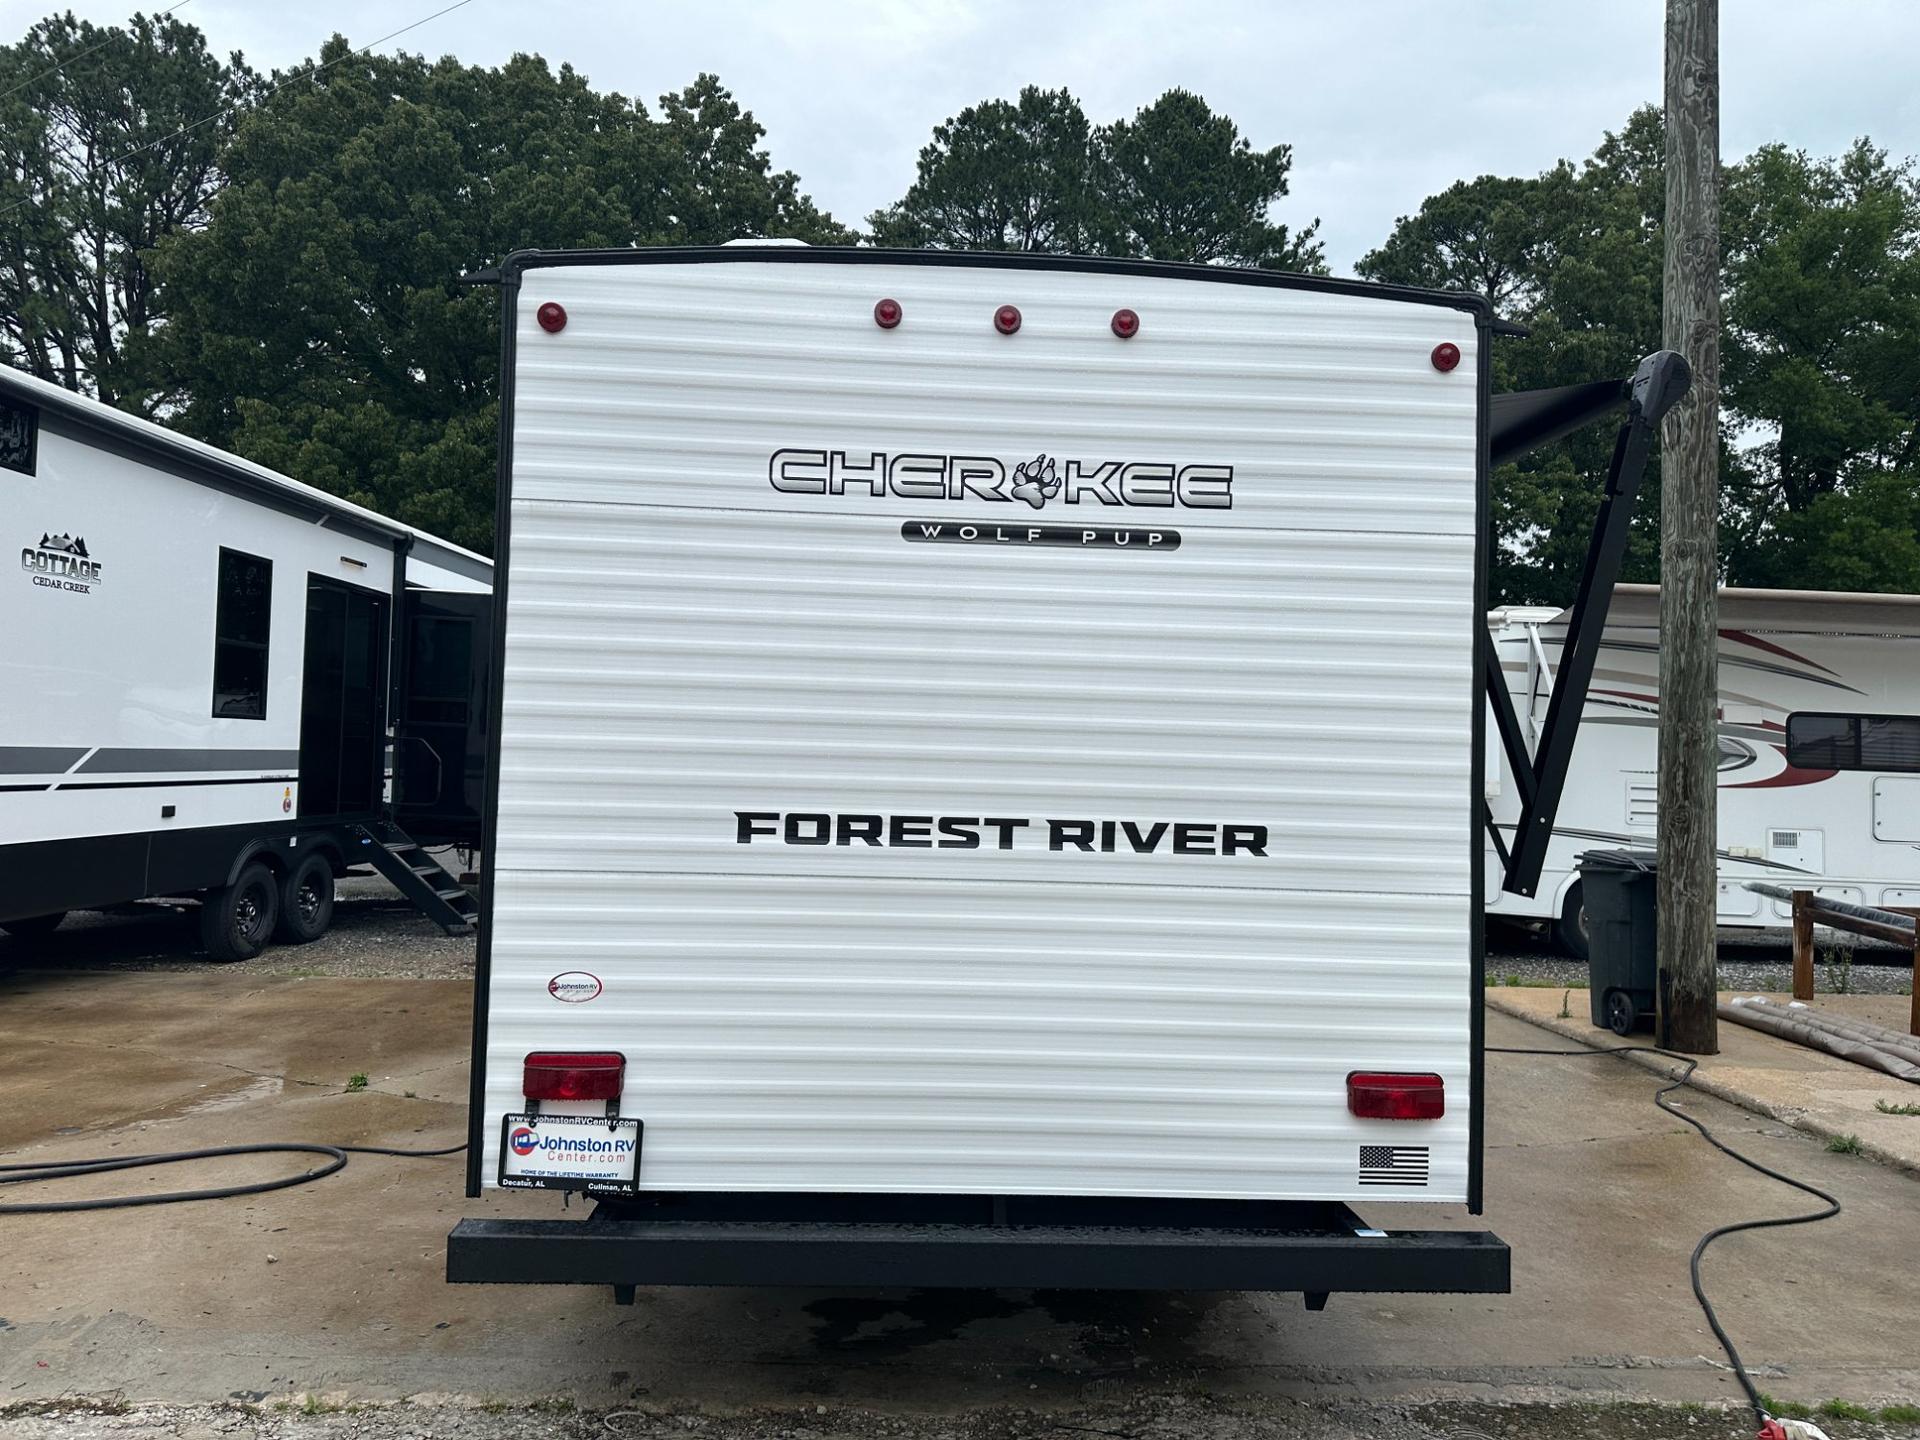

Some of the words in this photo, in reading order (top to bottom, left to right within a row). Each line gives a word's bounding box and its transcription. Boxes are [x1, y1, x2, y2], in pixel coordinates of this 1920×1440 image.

[920, 524, 1042, 542] WOLF
[1081, 530, 1164, 546] PUP
[22, 548, 101, 585] COTTAGE
[33, 576, 62, 589] CEDAR
[63, 582, 90, 594] CREEK
[733, 811, 1029, 849] FOREST
[1045, 819, 1269, 857] RIVER
[508, 1115, 638, 1127] wwwJohnstonRVCenter.com
[539, 1136, 612, 1152] Johnston
[615, 1139, 635, 1152] RV
[548, 1151, 626, 1163] Center.com
[502, 1178, 533, 1187] Decatur,
[535, 1180, 546, 1188] AL
[588, 1182, 620, 1191] Cullman,
